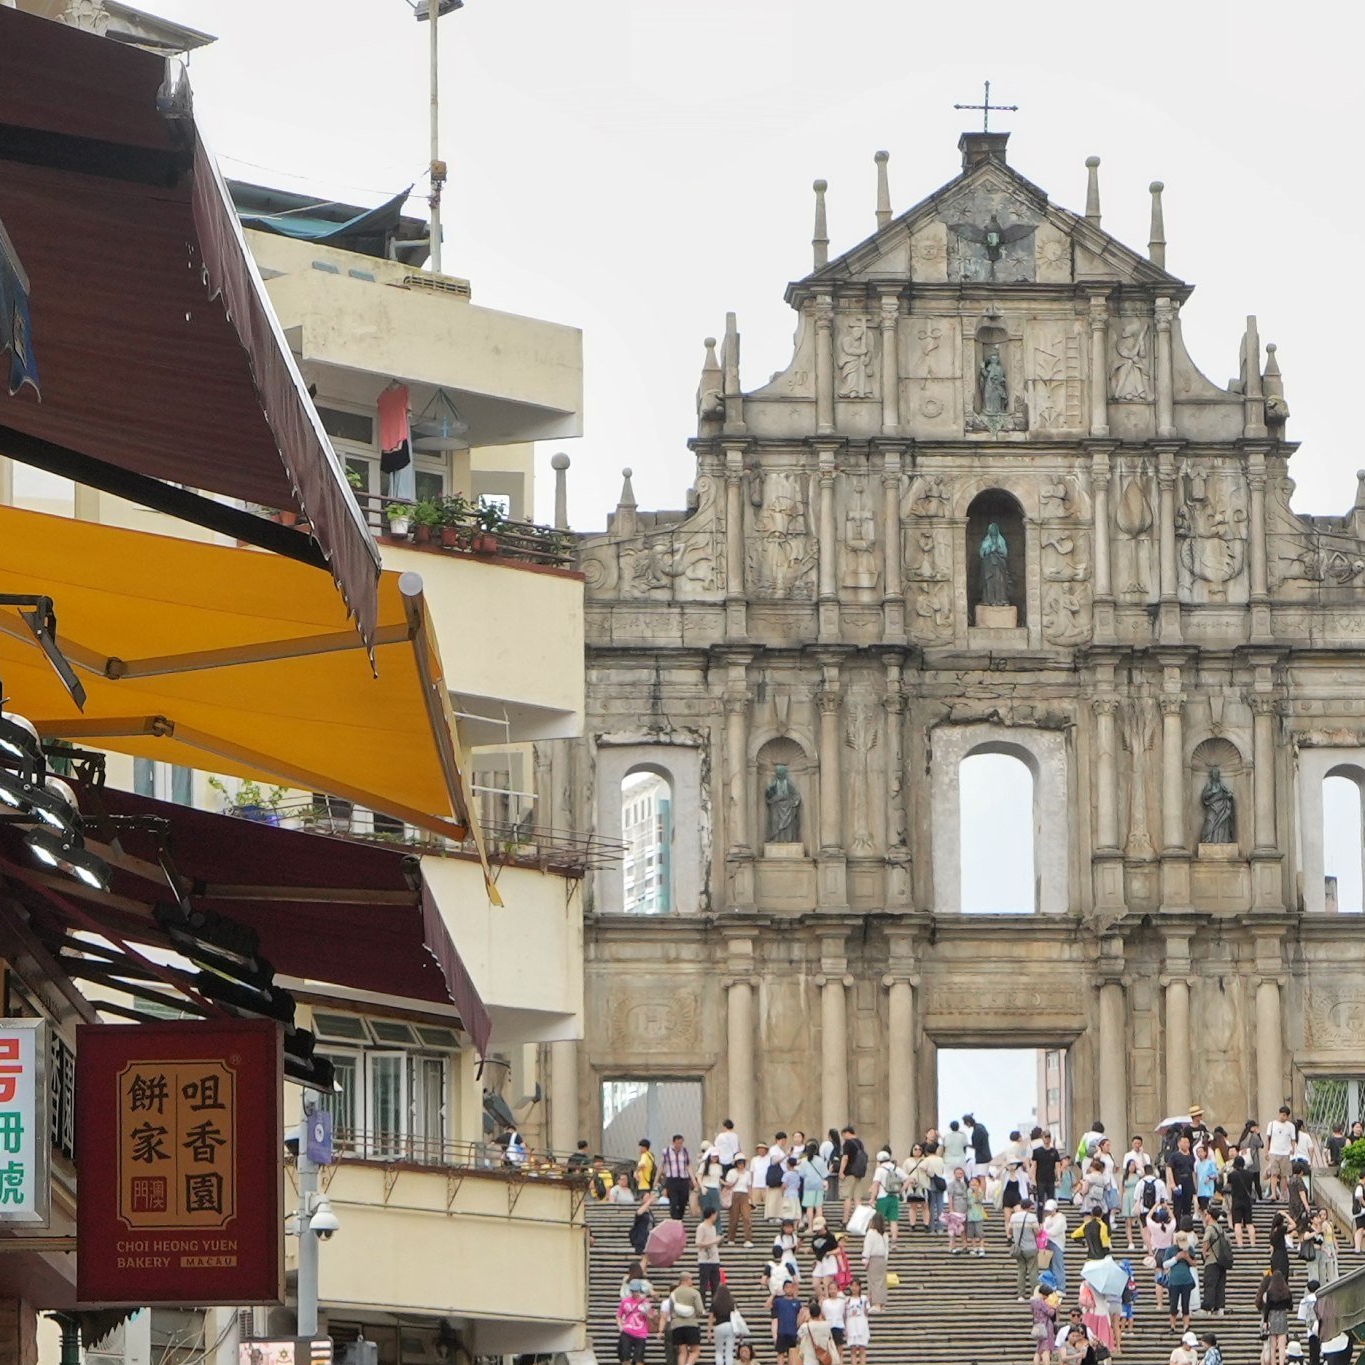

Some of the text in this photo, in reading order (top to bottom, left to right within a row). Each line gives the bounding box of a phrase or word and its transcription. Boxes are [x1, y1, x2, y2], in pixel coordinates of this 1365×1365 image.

[126, 1073, 171, 1164] 餅家
[182, 1074, 227, 1215] 咀香園
[117, 1239, 238, 1252] CHOI HEONG YUEN
[117, 1257, 233, 1269] BAKERY MACAU
